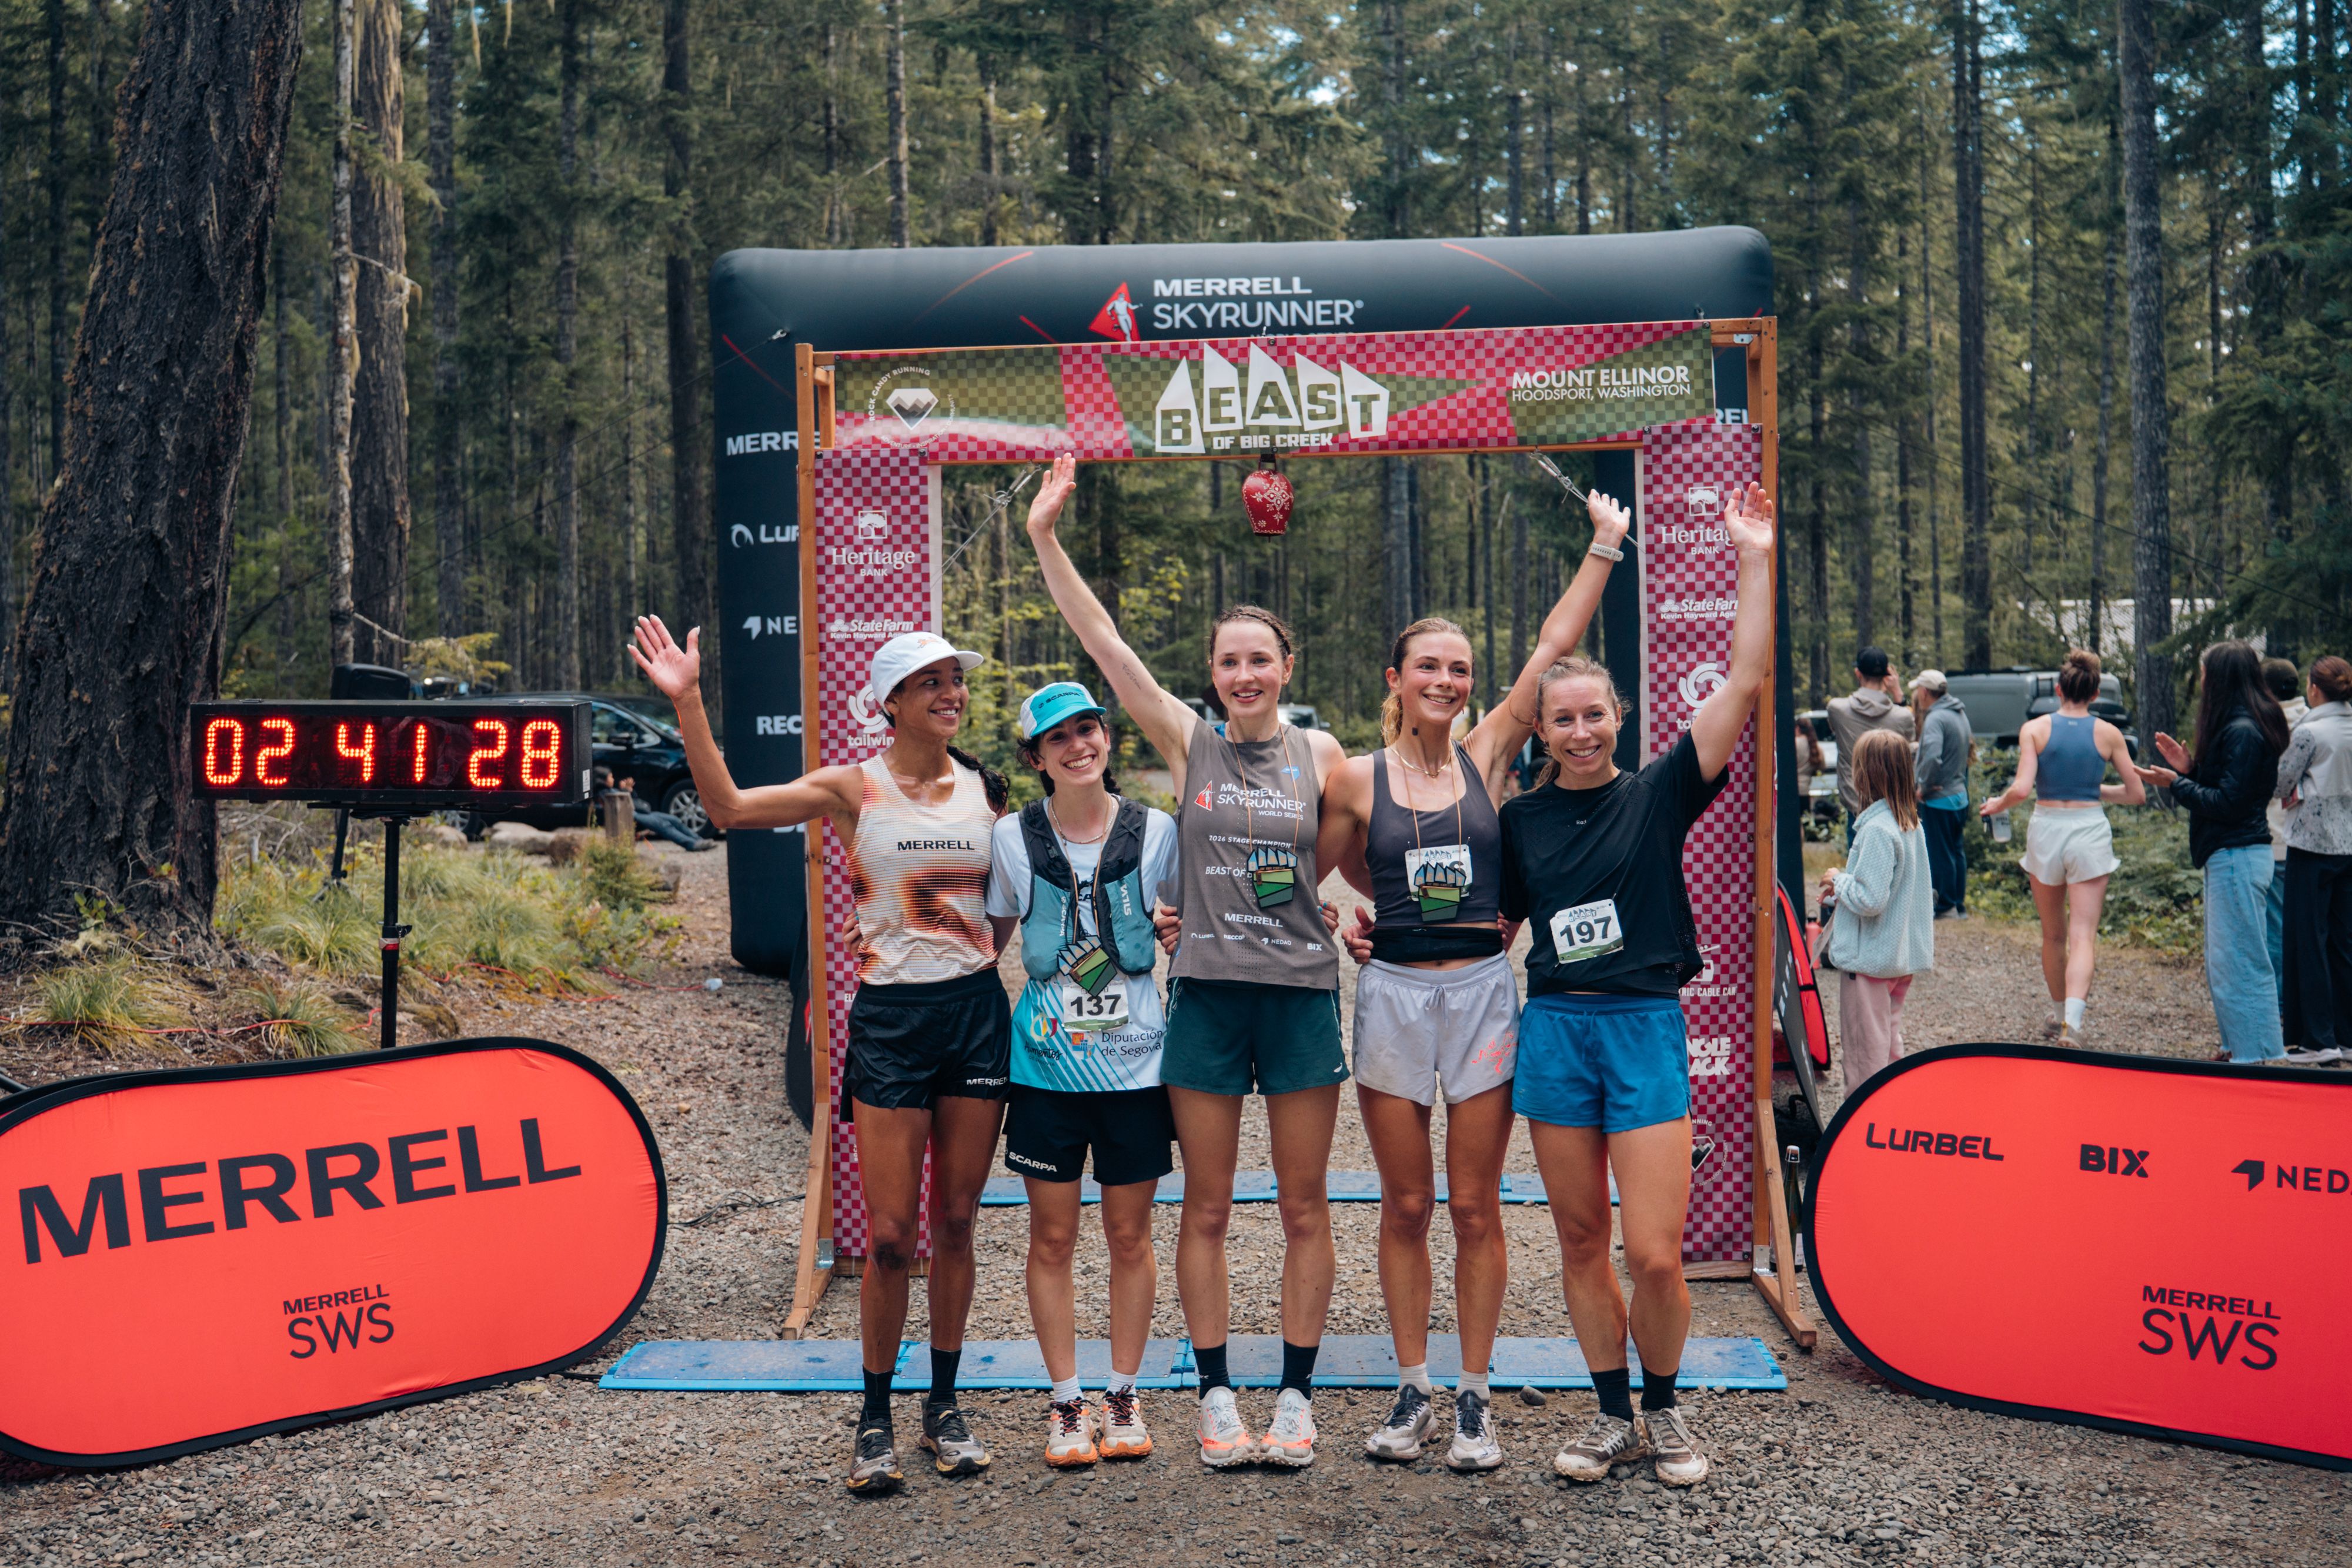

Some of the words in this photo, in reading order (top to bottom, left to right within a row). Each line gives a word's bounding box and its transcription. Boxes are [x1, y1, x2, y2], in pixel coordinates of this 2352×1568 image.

[1153, 276, 1312, 297] MERRELL
[1512, 369, 1595, 389] MOUNT
[1599, 365, 1690, 386] ELLINOR
[868, 398, 876, 421] ROCK
[872, 373, 891, 396] CANDY
[892, 366, 930, 376] RUNNING
[1155, 353, 1390, 453] BEAST
[1512, 387, 1594, 402] HOODSPORT,
[1596, 383, 1691, 399] WASHINGTON
[1212, 436, 1235, 450] OF
[1240, 434, 1271, 449] BIG
[1275, 432, 1334, 447] CREEK
[831, 547, 916, 570] Heritage
[1690, 546, 1720, 555] BANK
[860, 568, 888, 576] BANK
[1683, 611, 1718, 620] Hayward
[1045, 692, 1081, 704] SCARPA
[1220, 783, 1286, 797] MERRELL
[897, 840, 975, 851] MERRELL
[1252, 839, 1291, 849] CHAMPION
[1205, 866, 1232, 875] BEAST
[1232, 868, 1246, 878] OF
[1120, 884, 1132, 916] SILVA
[1224, 912, 1284, 928] MERRELL
[1559, 915, 1612, 947] 197
[1307, 942, 1323, 951] BIX
[1697, 987, 1720, 997] CABLE
[1070, 994, 1121, 1017] 137
[1101, 1028, 1163, 1045] Diputación
[1101, 1047, 1117, 1057] de
[1120, 1042, 1162, 1057] Segova
[1688, 1057, 1731, 1076] ACK
[1866, 1123, 2004, 1162] LURBEL
[1008, 1151, 1058, 1172] SCARPA
[2079, 1144, 2150, 1179] BIX
[2277, 1164, 2352, 1195] NED
[19, 1118, 582, 1265] MERRELL
[283, 1283, 390, 1315] MERRELL
[2143, 1285, 2281, 1320] MERRELL
[288, 1302, 395, 1359] SWS
[2138, 1308, 2280, 1371] SWS
